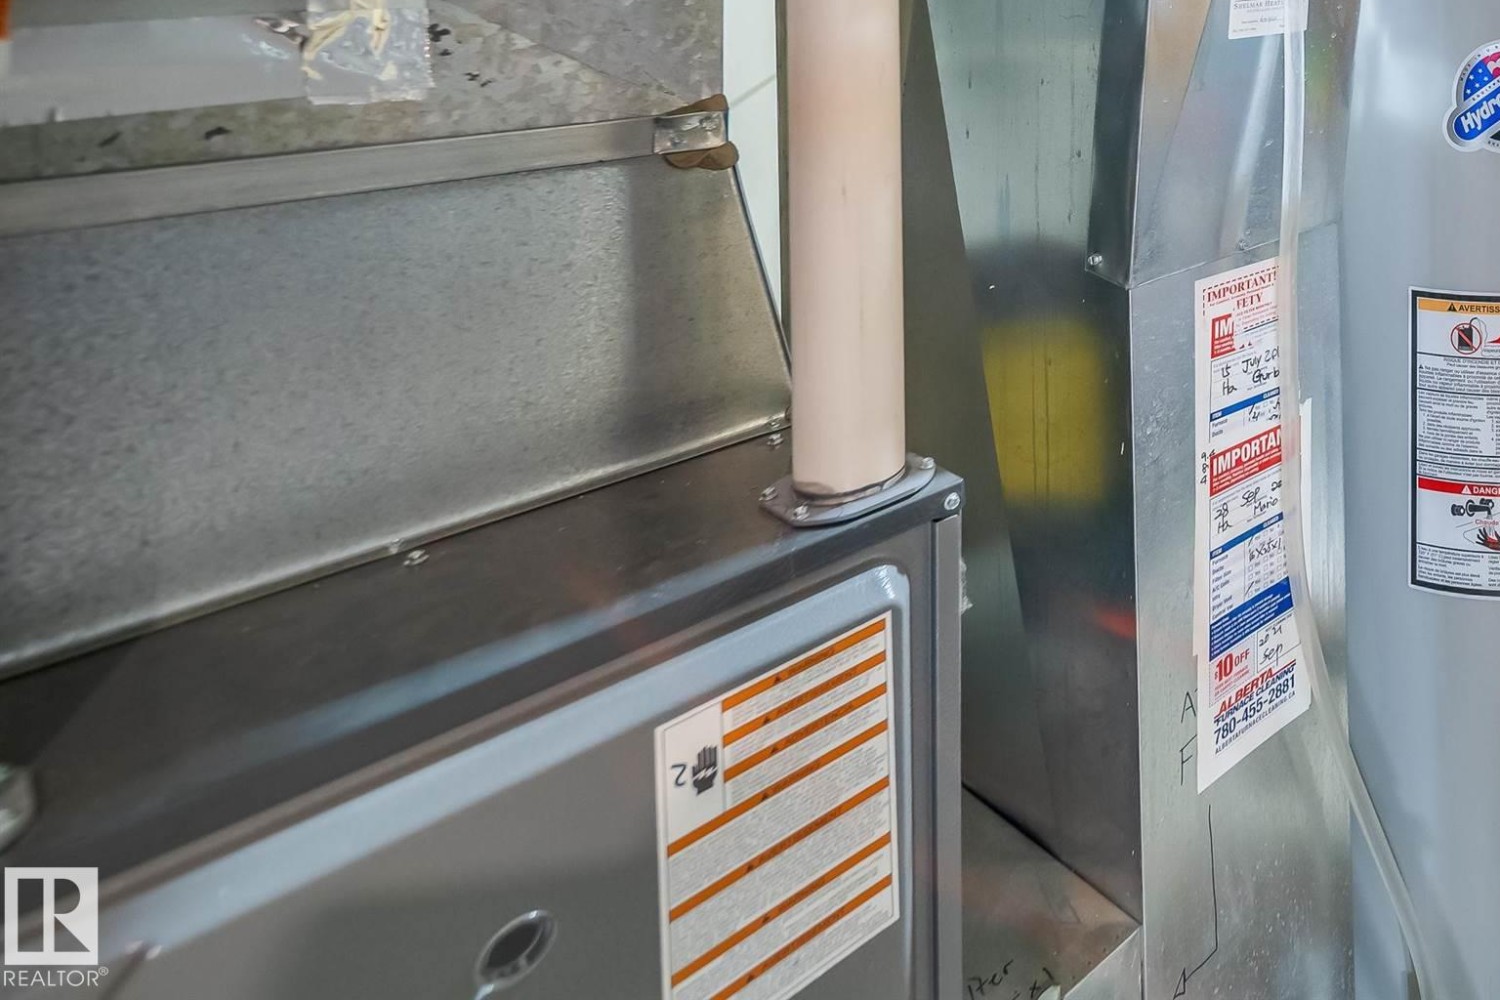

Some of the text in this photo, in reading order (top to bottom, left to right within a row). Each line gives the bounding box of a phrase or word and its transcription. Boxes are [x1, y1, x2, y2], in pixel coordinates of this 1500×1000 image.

[1207, 270, 1277, 303] IMPORTANT!
[1236, 292, 1263, 310] FETY
[1241, 355, 1262, 374] July
[1213, 428, 1281, 477] IMPORTA
[1214, 652, 1234, 682] $10
[1234, 648, 1250, 667] OFF
[1213, 673, 1295, 745] 780-455-2881
[1214, 691, 1255, 727] FURNACE
[1255, 663, 1297, 701] CLEANING
[1218, 667, 1274, 716] ALBERTA
[1215, 690, 1296, 755] ALBERTAFURNACECLEANING.CA
